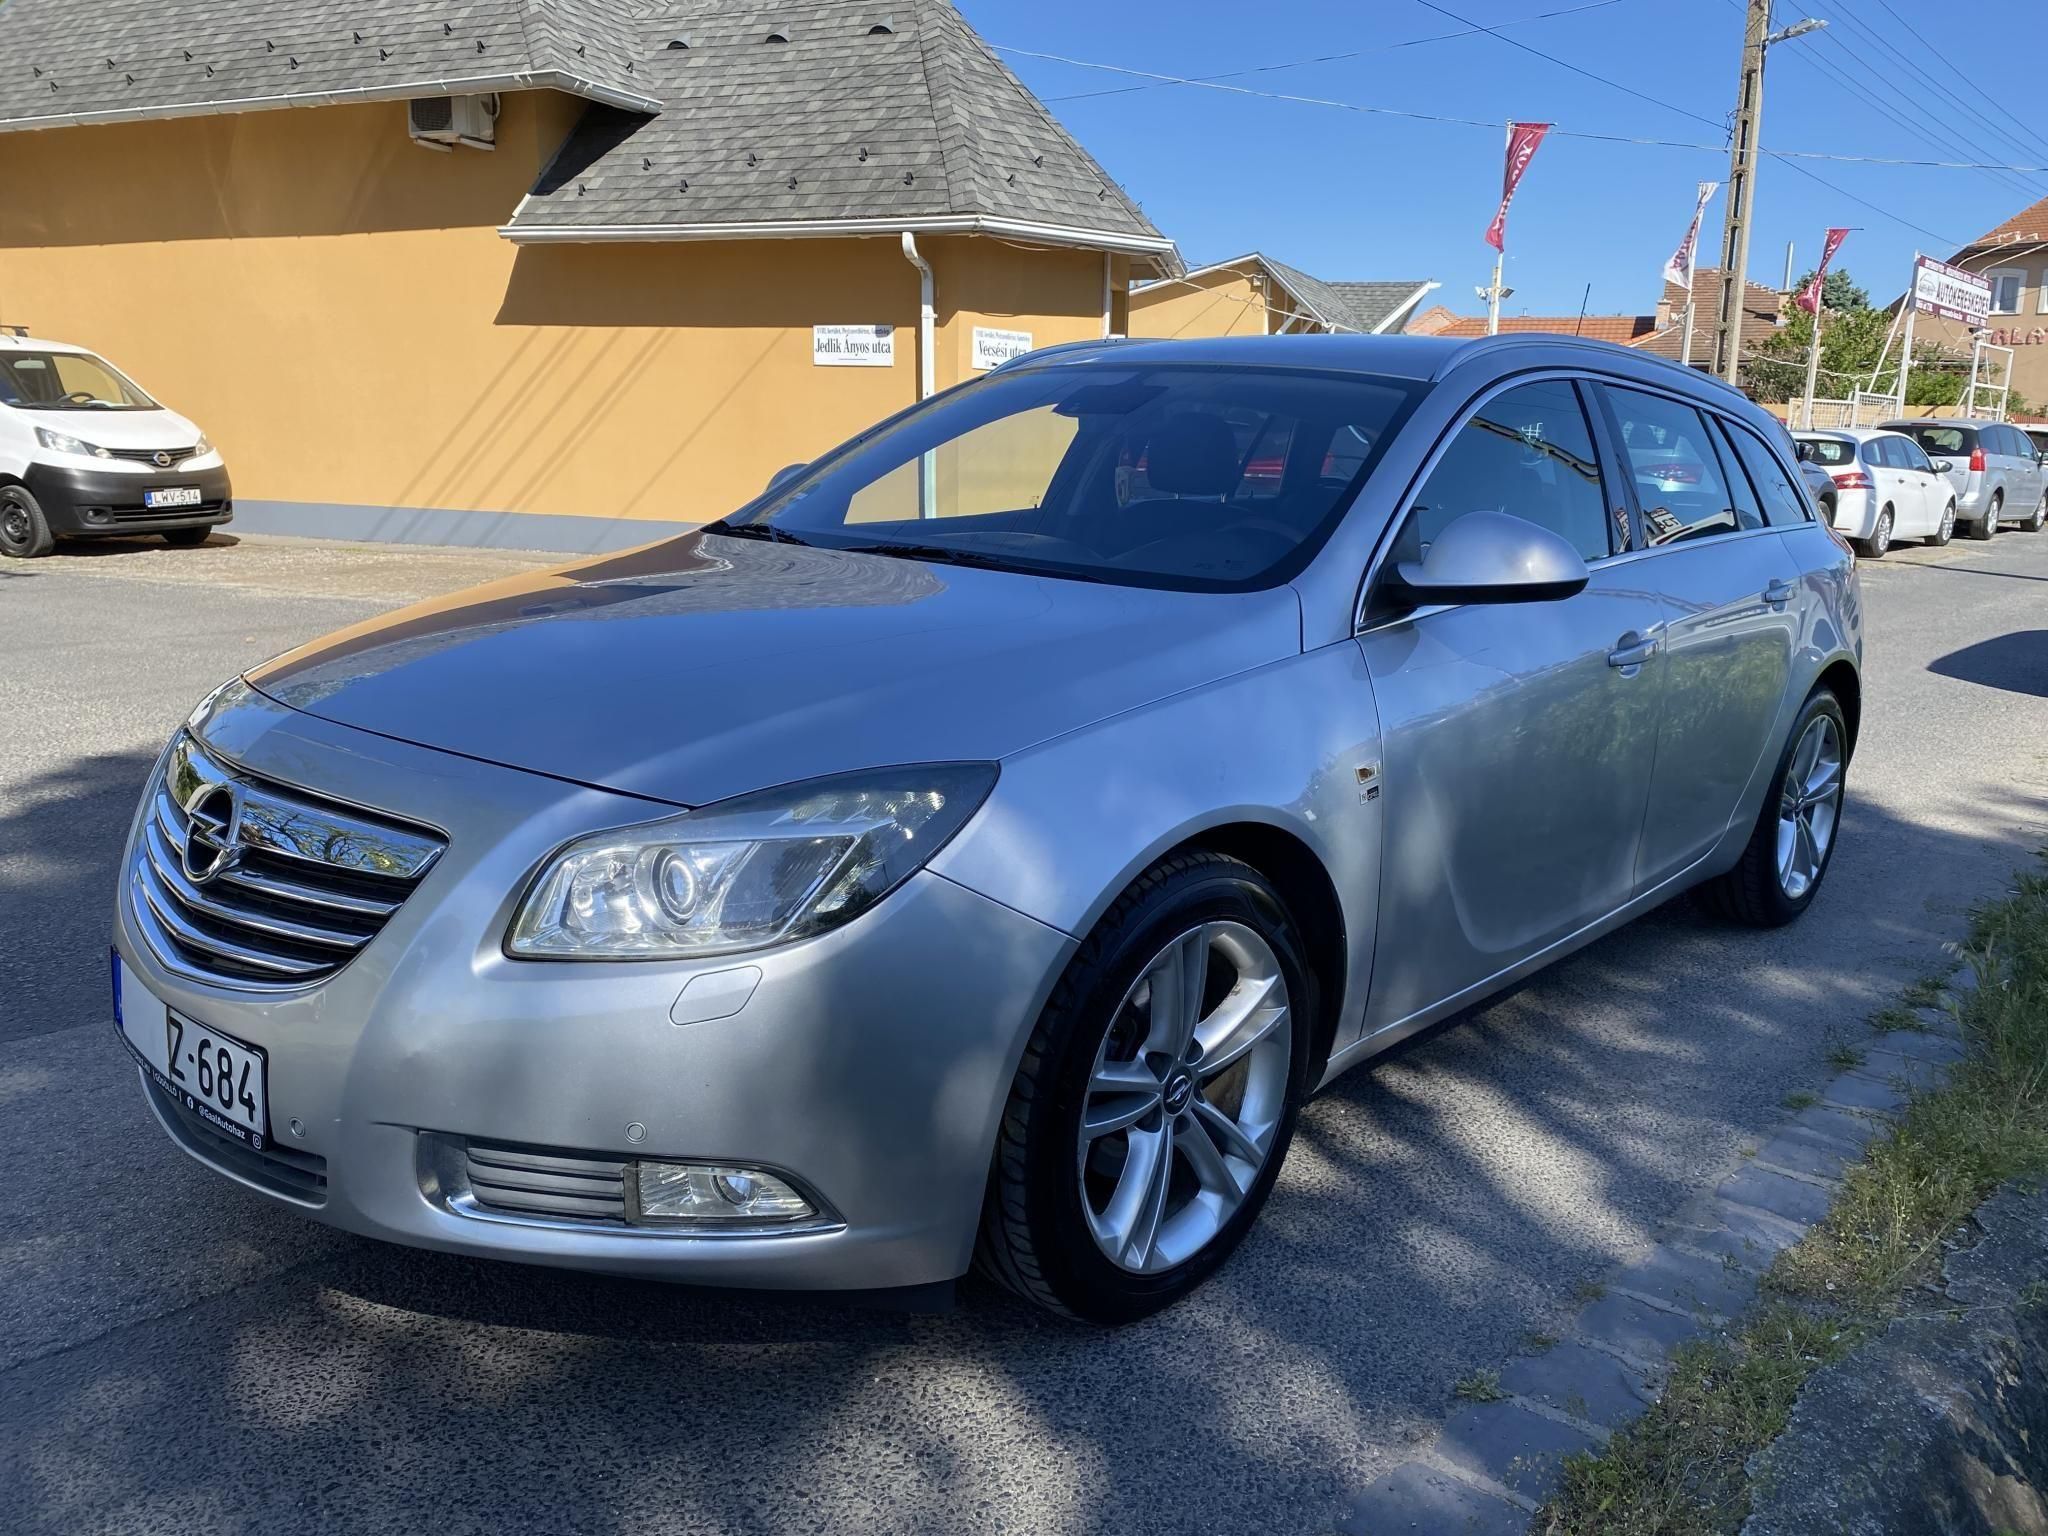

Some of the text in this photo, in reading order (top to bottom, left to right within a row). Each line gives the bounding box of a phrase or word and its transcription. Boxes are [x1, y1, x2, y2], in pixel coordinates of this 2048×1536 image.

[815, 334, 892, 357] Jedlik Ányos utca
[979, 340, 1008, 358] Vecsési
[154, 491, 199, 504] LWV-514
